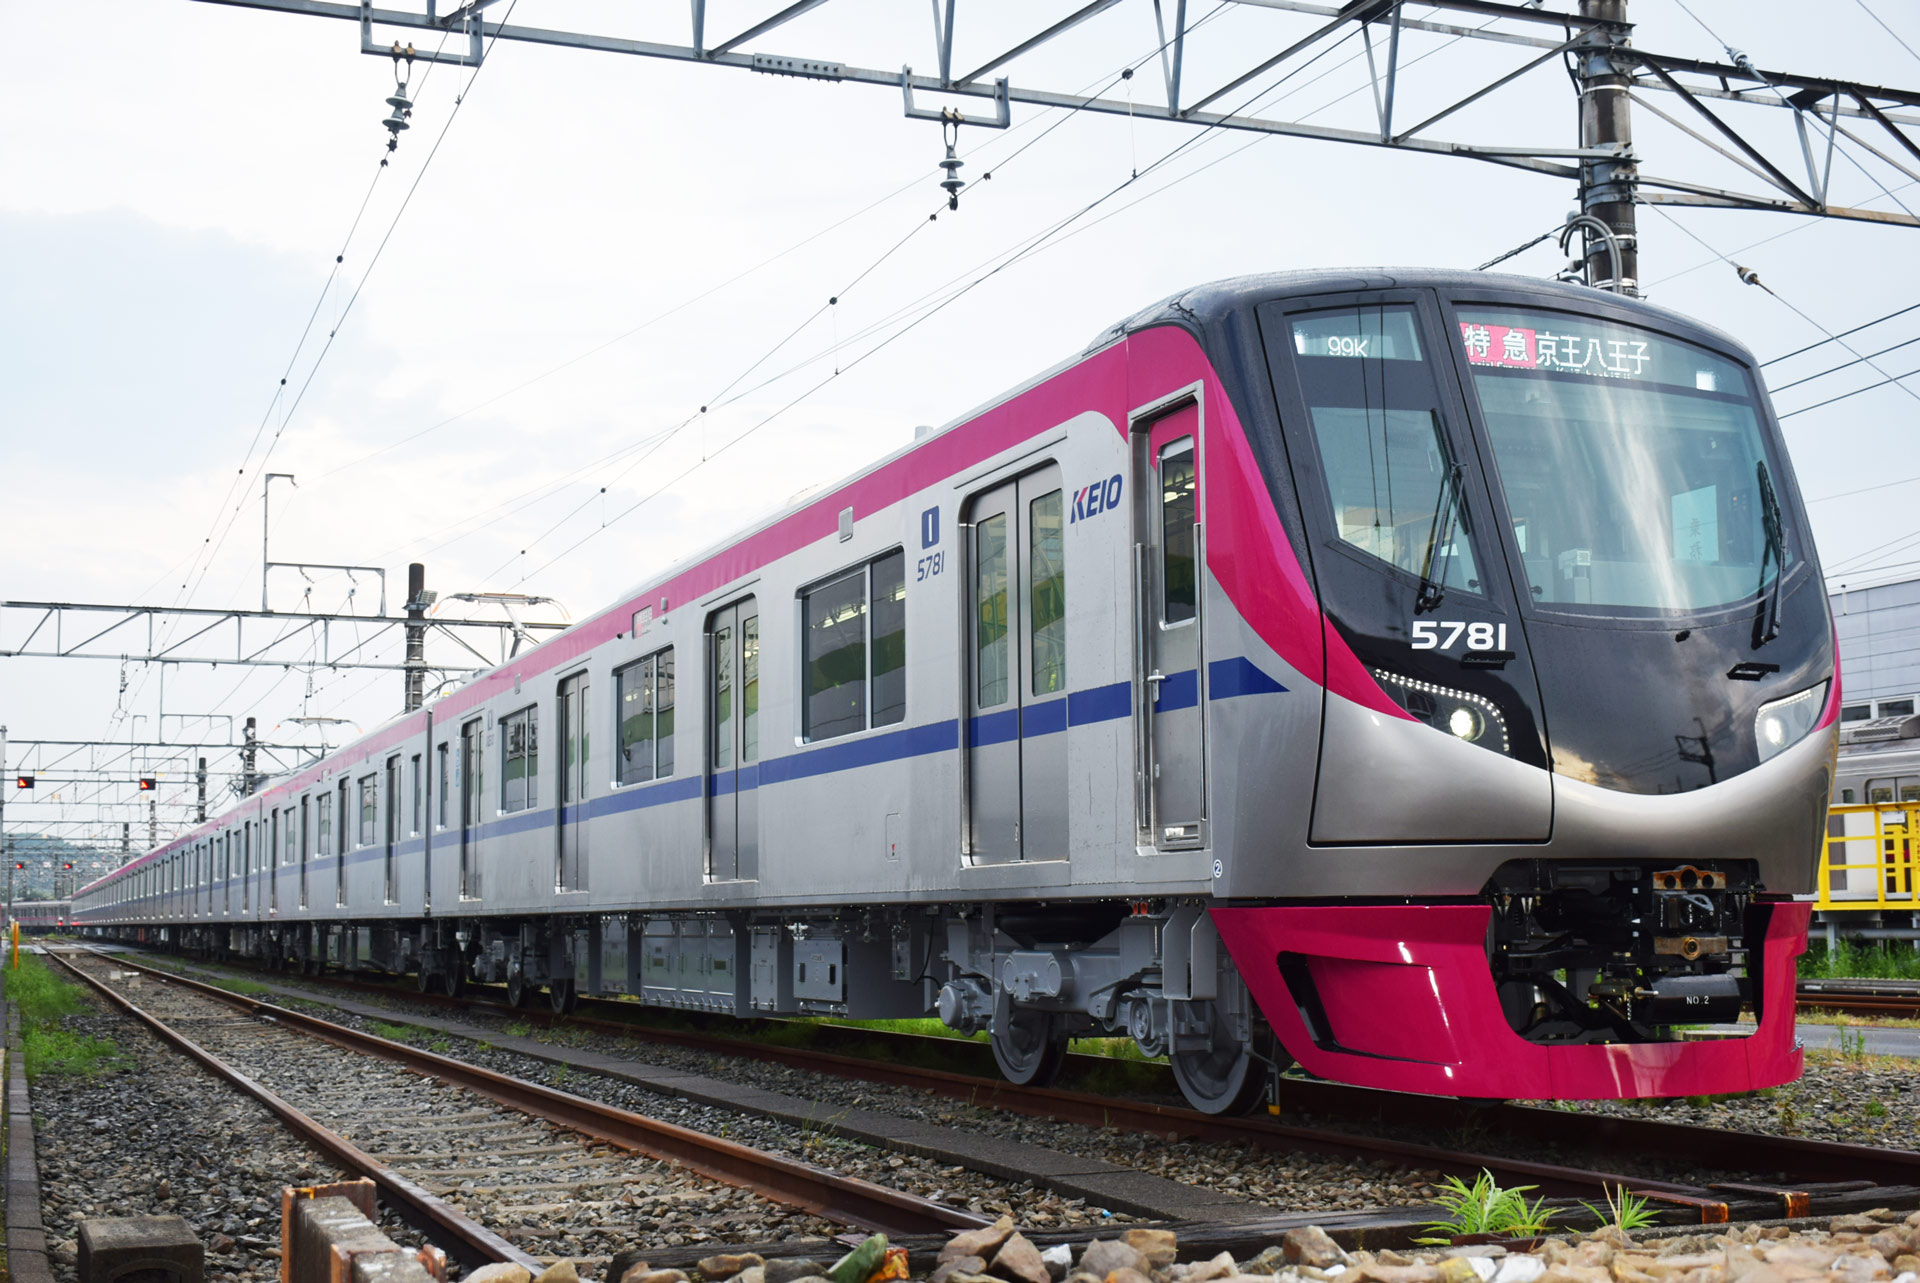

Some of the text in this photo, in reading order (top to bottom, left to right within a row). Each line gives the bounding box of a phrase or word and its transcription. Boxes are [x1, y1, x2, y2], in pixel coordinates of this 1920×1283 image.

[1328, 336, 1368, 357] 99K
[1535, 331, 1650, 375] 京王八王子
[1070, 473, 1123, 525] KEIO
[917, 550, 945, 582] 5781
[1411, 621, 1507, 651] 5781
